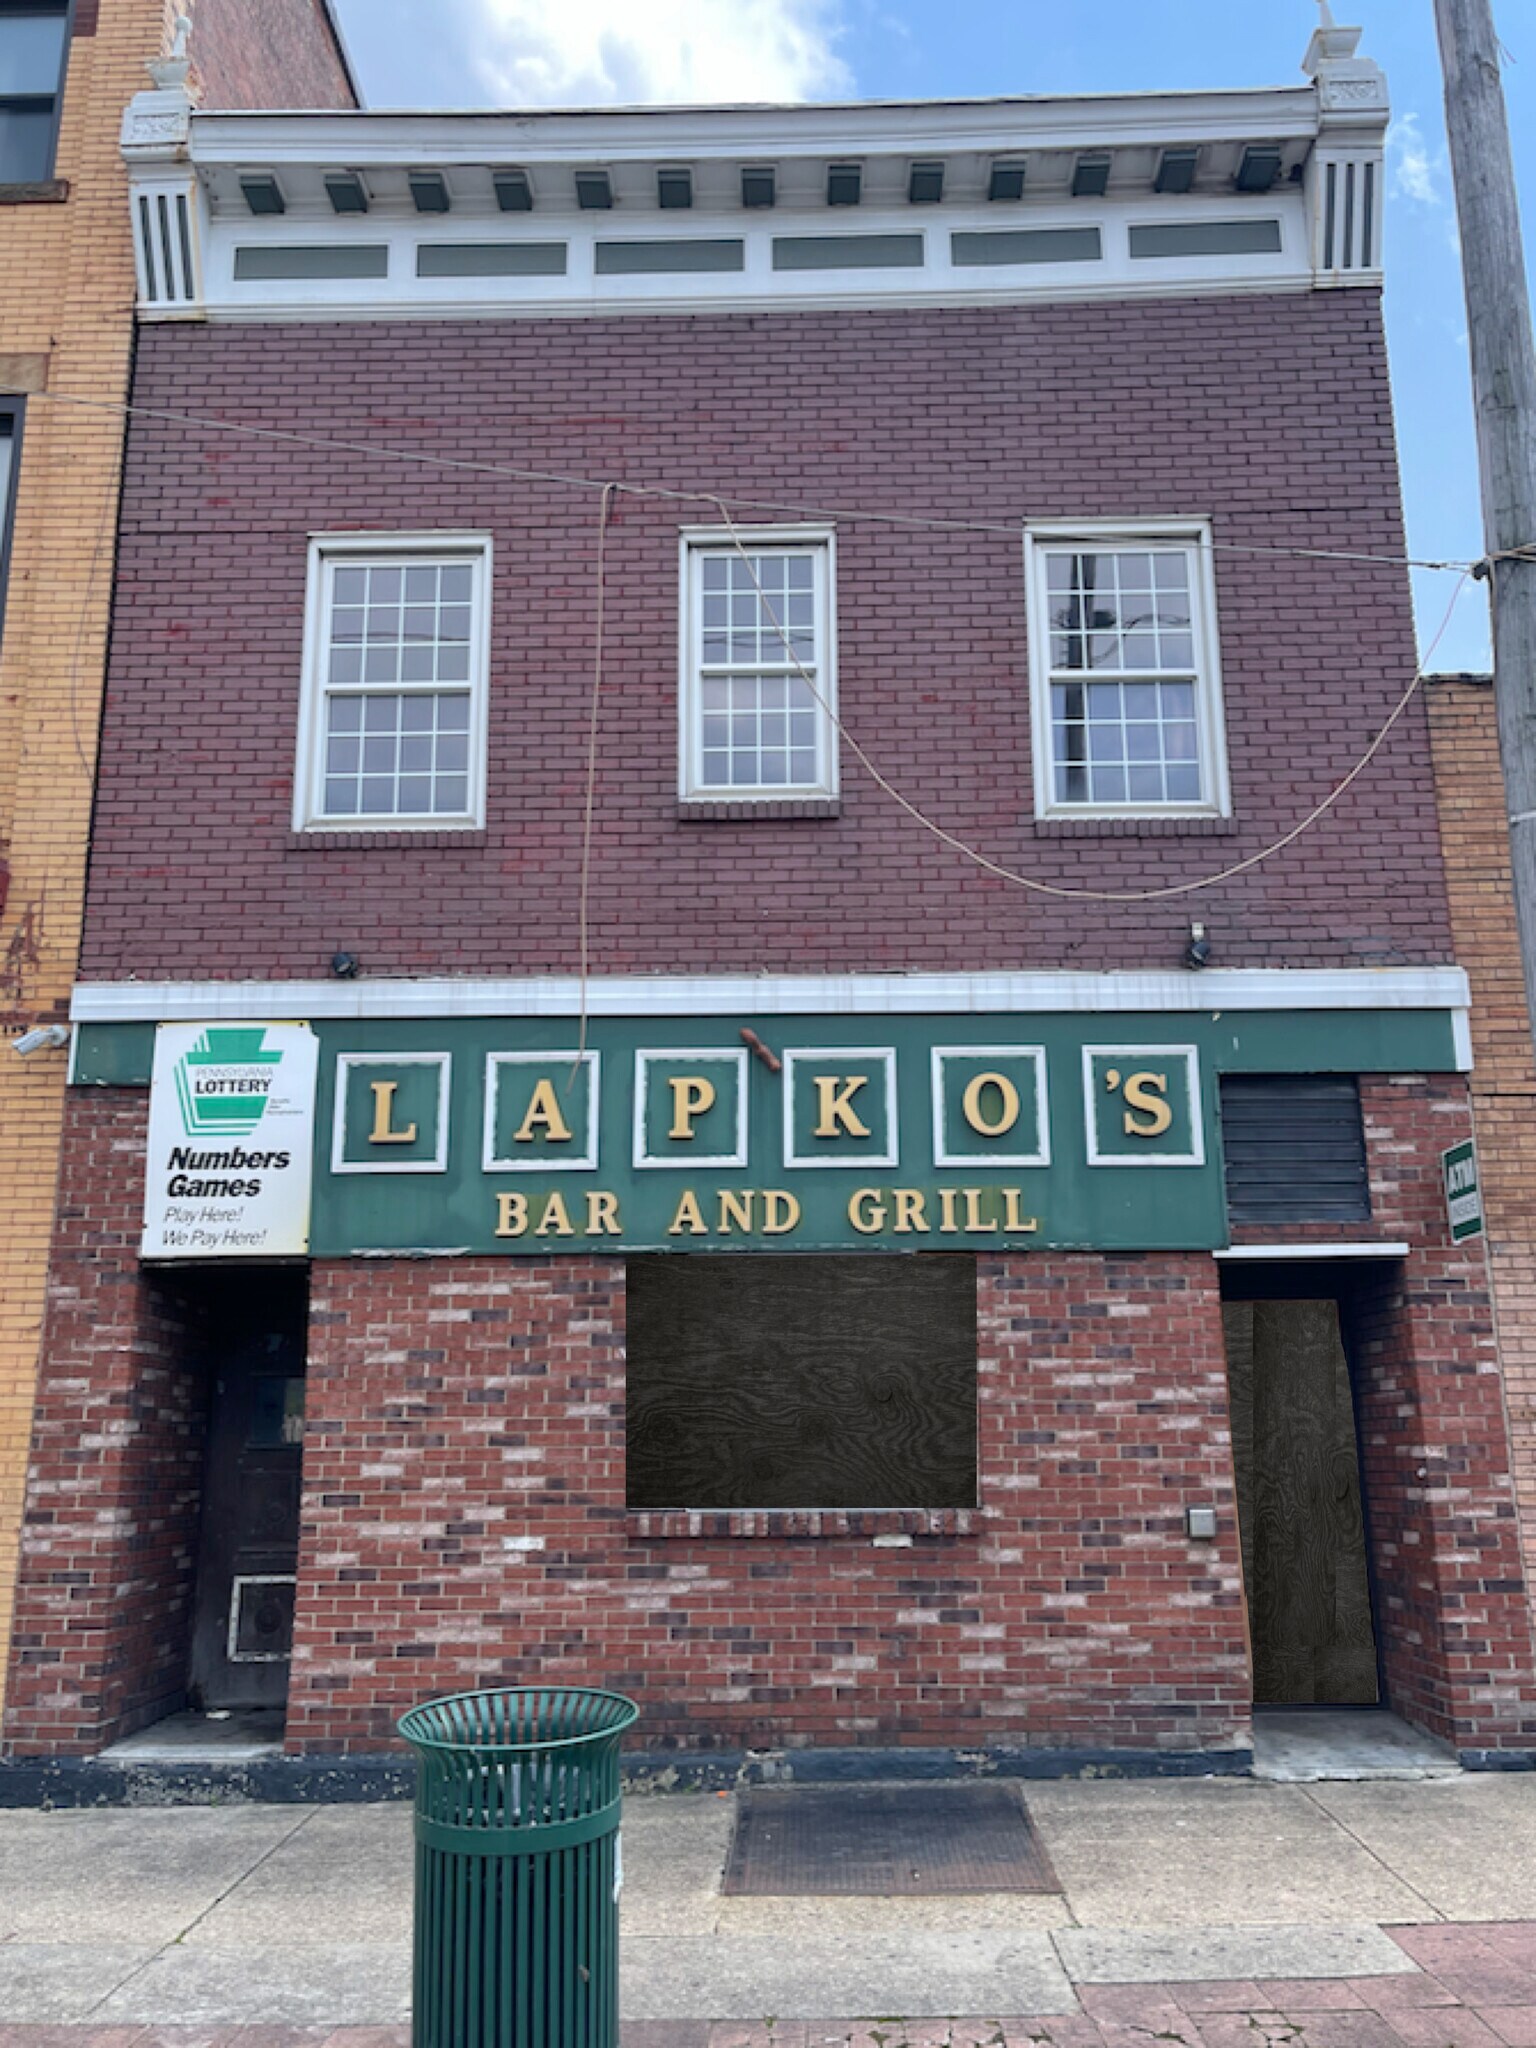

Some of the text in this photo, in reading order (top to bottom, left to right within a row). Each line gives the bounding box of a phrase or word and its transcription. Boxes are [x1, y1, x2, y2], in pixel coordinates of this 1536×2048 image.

[194, 1078, 273, 1094] LOTTERY
[368, 1068, 1173, 1143] LAPKO'S
[167, 1145, 292, 1170] Numbers
[167, 1173, 262, 1198] Games
[163, 1205, 245, 1226] Play Here!
[494, 1187, 1038, 1237] BAR AND GRILL
[162, 1228, 268, 1249] We Pay Here!
